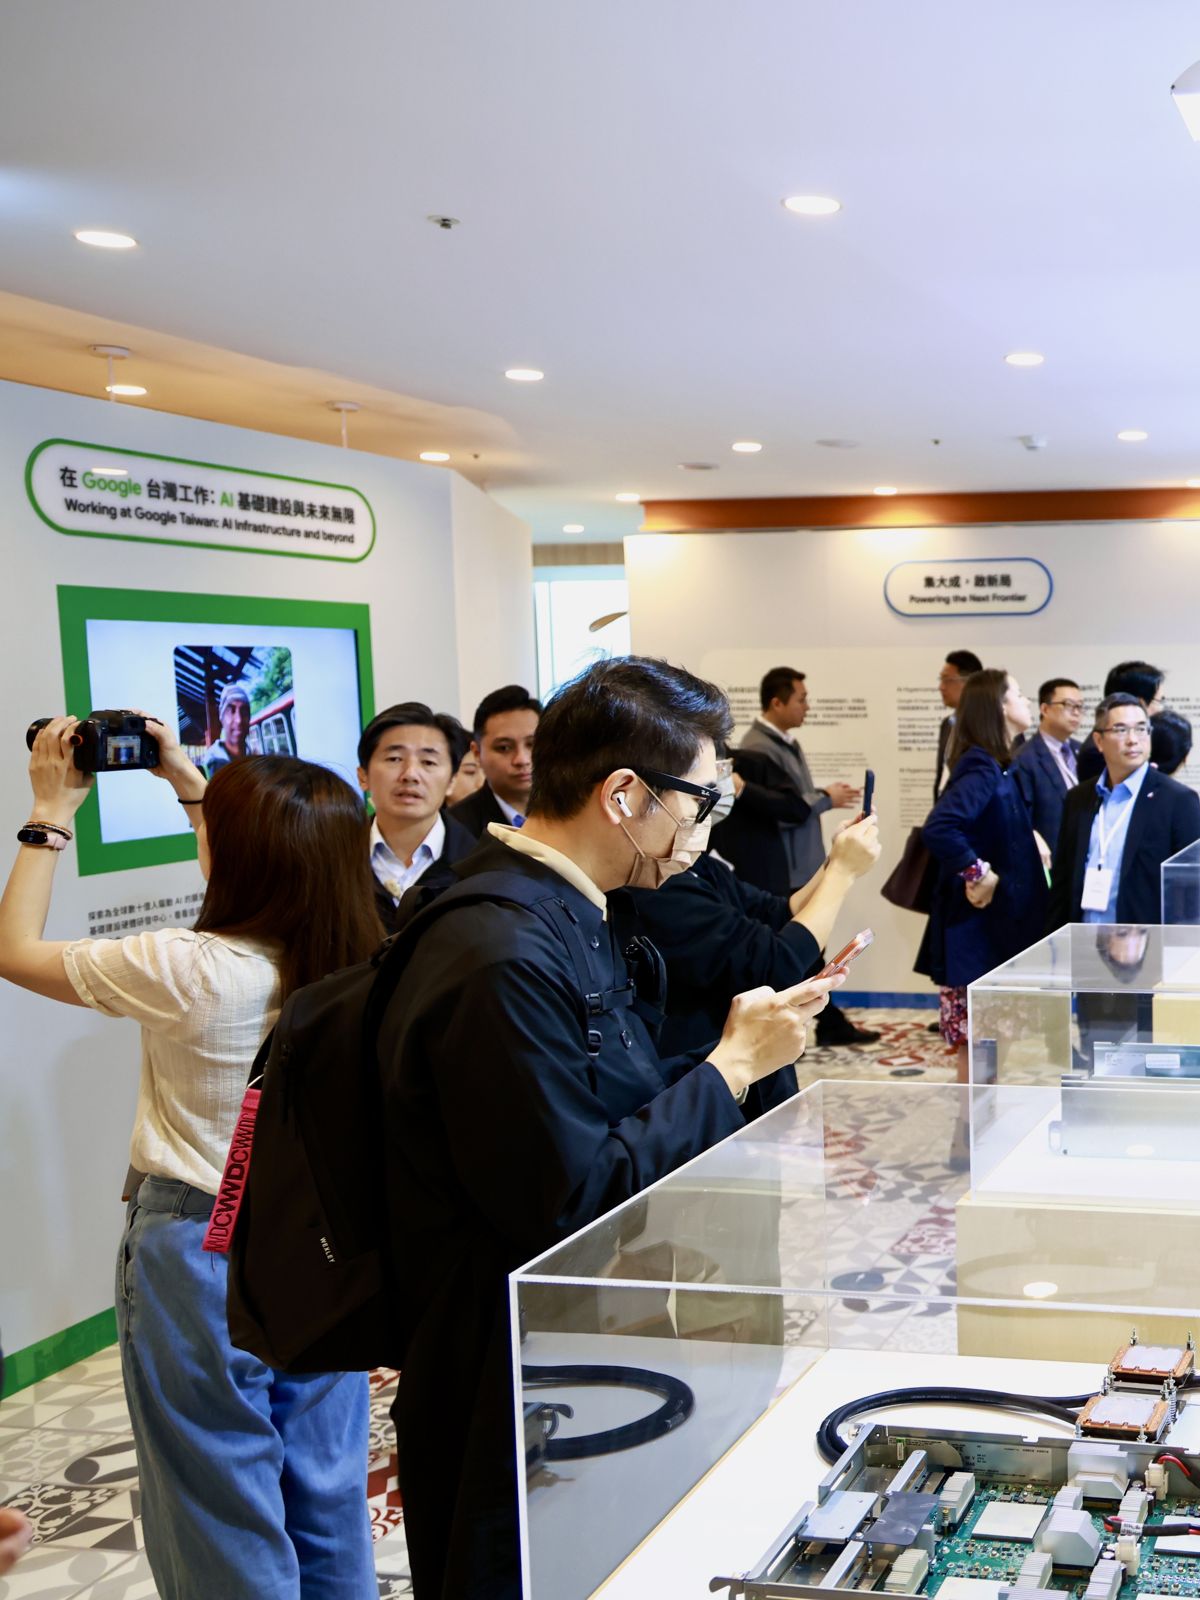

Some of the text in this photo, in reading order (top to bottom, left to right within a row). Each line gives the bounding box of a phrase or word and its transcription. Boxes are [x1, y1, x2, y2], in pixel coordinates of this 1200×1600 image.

[59, 467, 78, 489] 在
[82, 471, 142, 497] Google
[220, 492, 235, 507] AI
[64, 498, 355, 544] Working at Google Taiwan: AI Infrastructure and beyond
[909, 593, 1027, 605] Powering the Next Frontier
